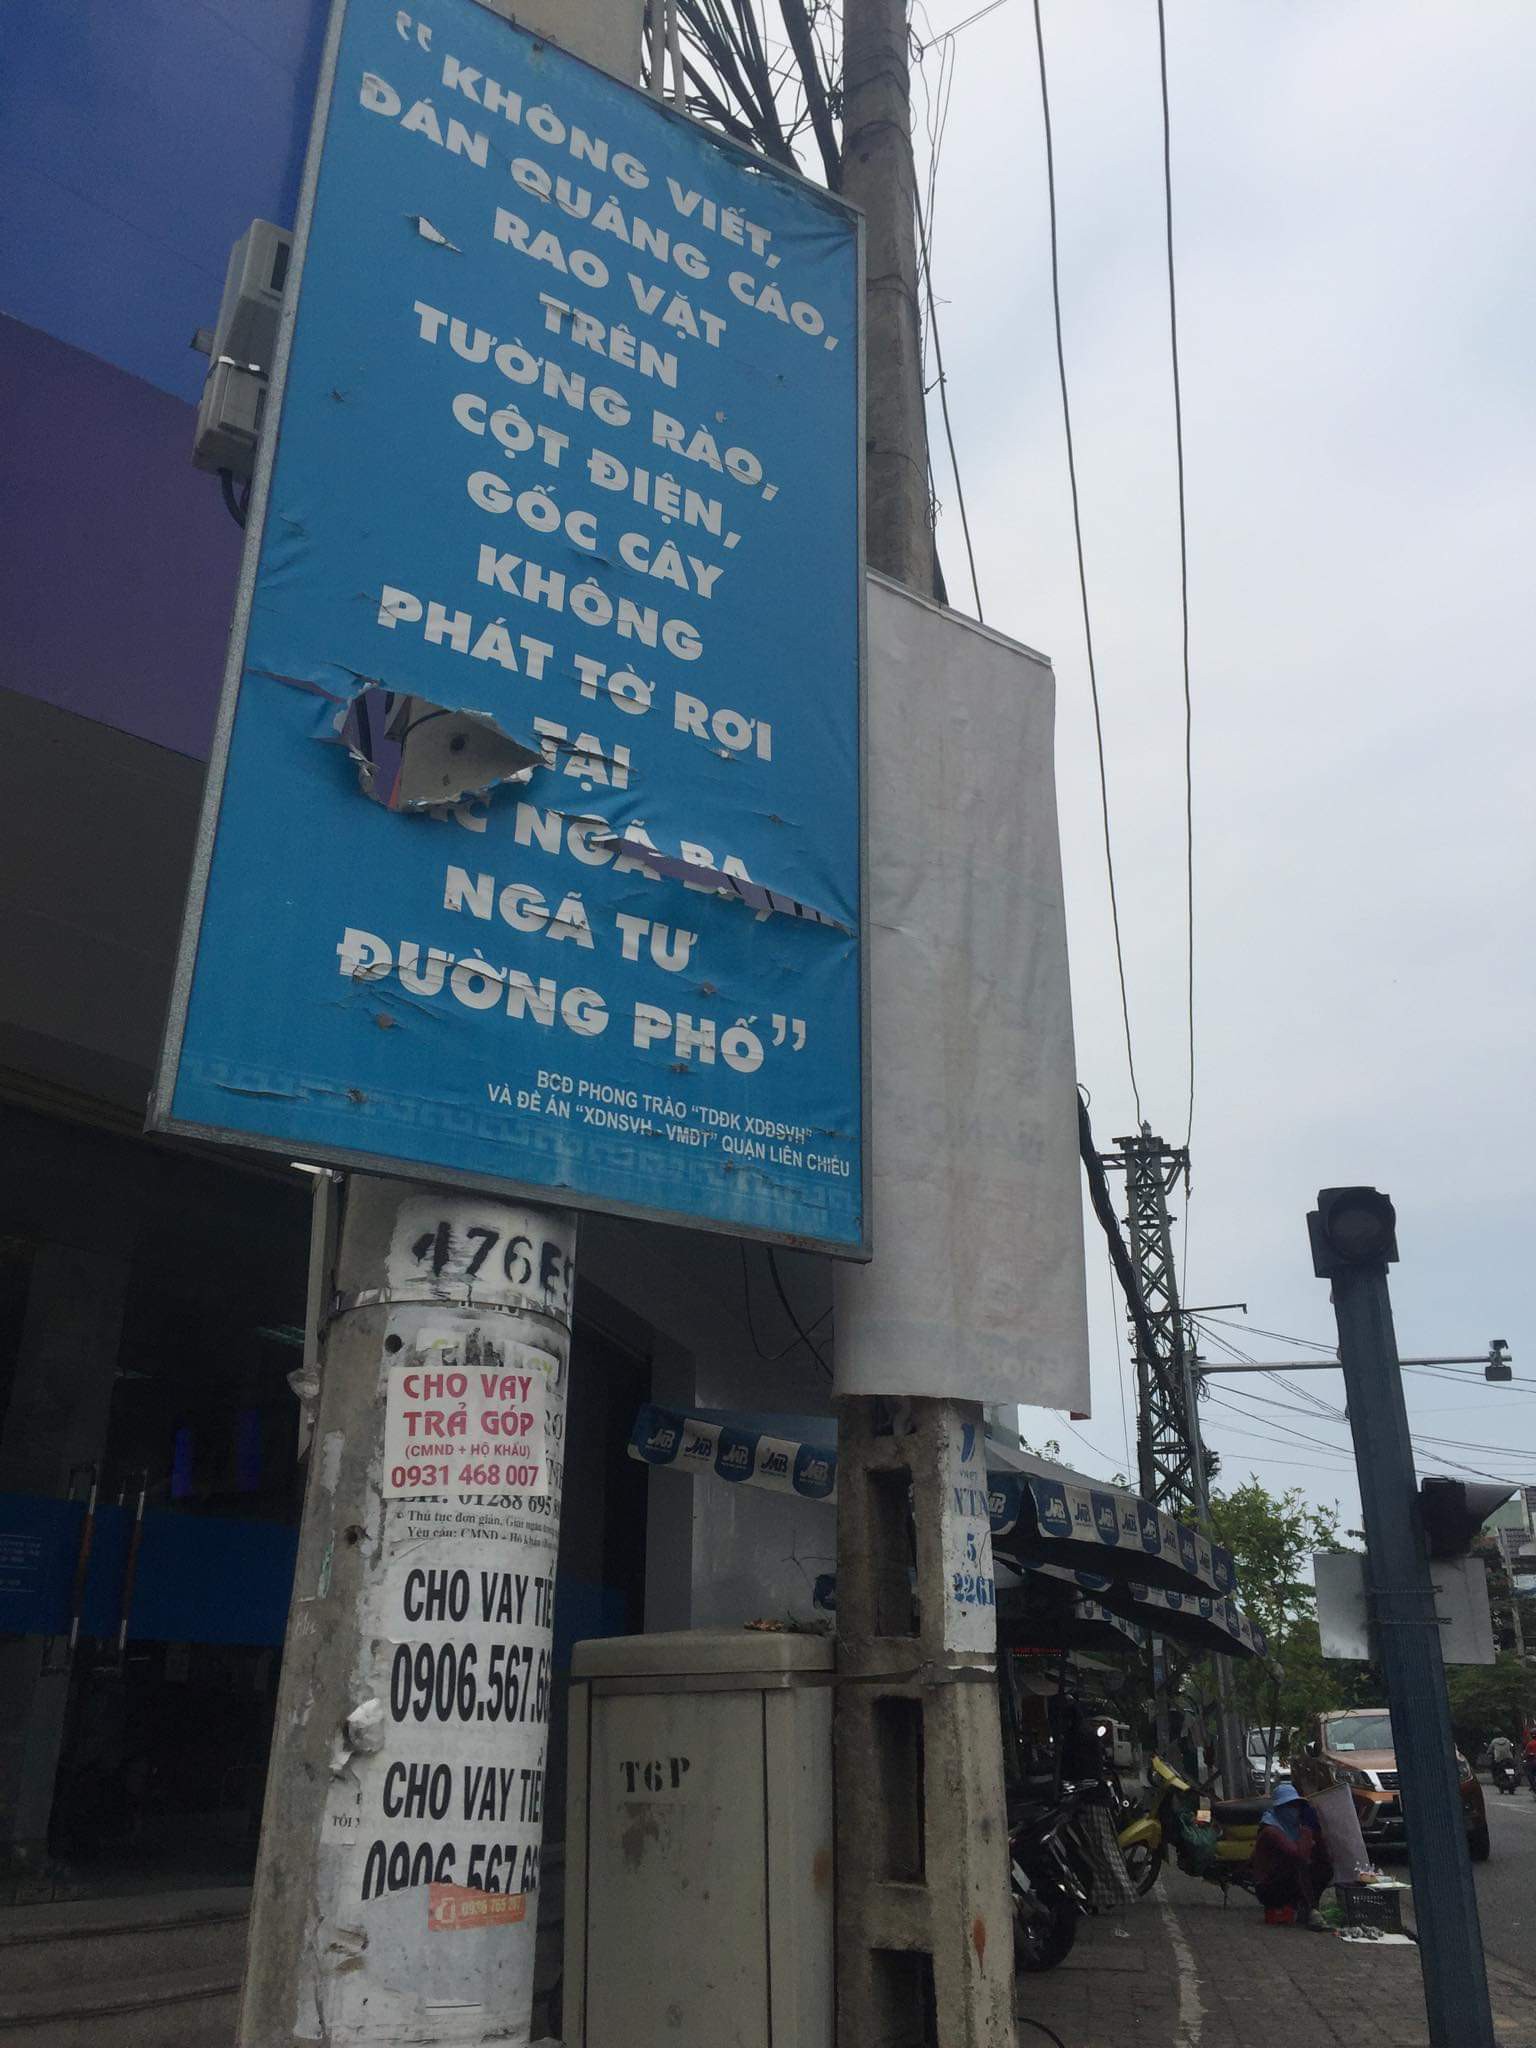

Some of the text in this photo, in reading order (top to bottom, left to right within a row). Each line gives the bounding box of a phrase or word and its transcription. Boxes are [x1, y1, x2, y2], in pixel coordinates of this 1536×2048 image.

[360, 71, 838, 351] DÁN QUẢNG CÁO,
[667, 176, 782, 268] VIẾT,
[494, 206, 727, 349] RAO VẶT
[539, 291, 678, 389] TRÊN
[414, 300, 779, 502] TƯỜNG RÀO,
[452, 393, 742, 549] CỘT ĐIỆN,
[467, 470, 724, 599] GỐC CÂY
[477, 544, 703, 661] KHÔNG
[376, 584, 772, 761] PHÁT TỜ RƠI
[533, 716, 632, 790] TẠI
[514, 802, 661, 881] NGÃ
[443, 864, 699, 972] NGÃ TƯ
[336, 927, 609, 1037] ĐƯỜNG
[488, 1083, 513, 1106] VÀ
[516, 1089, 542, 1112] ĐỀ
[545, 1094, 571, 1119] ÁN
[576, 1104, 652, 1137] “XDNSVH
[770, 1145, 802, 1168] LIÊN
[537, 1070, 574, 1094] BCĐ
[578, 1080, 638, 1109] PHONG
[642, 1094, 687, 1119] TRÀO
[691, 1104, 741, 1130] “TDĐK
[403, 1373, 533, 1402] CHO VAY
[403, 1402, 467, 1440] TRẢ
[480, 1405, 534, 1438] GÓP
[391, 1464, 449, 1488] 0931
[458, 1464, 500, 1486] 468
[505, 1464, 539, 1487] 007
[405, 1444, 455, 1459] (CMND
[469, 1440, 490, 1458] HỘ
[460, 1528, 499, 1541] CMND
[403, 1568, 471, 1623] CHO
[481, 1571, 529, 1625] VAY
[383, 1761, 452, 1821] CHO
[464, 1766, 515, 1822] VAY
[620, 1757, 690, 1792] T6P
